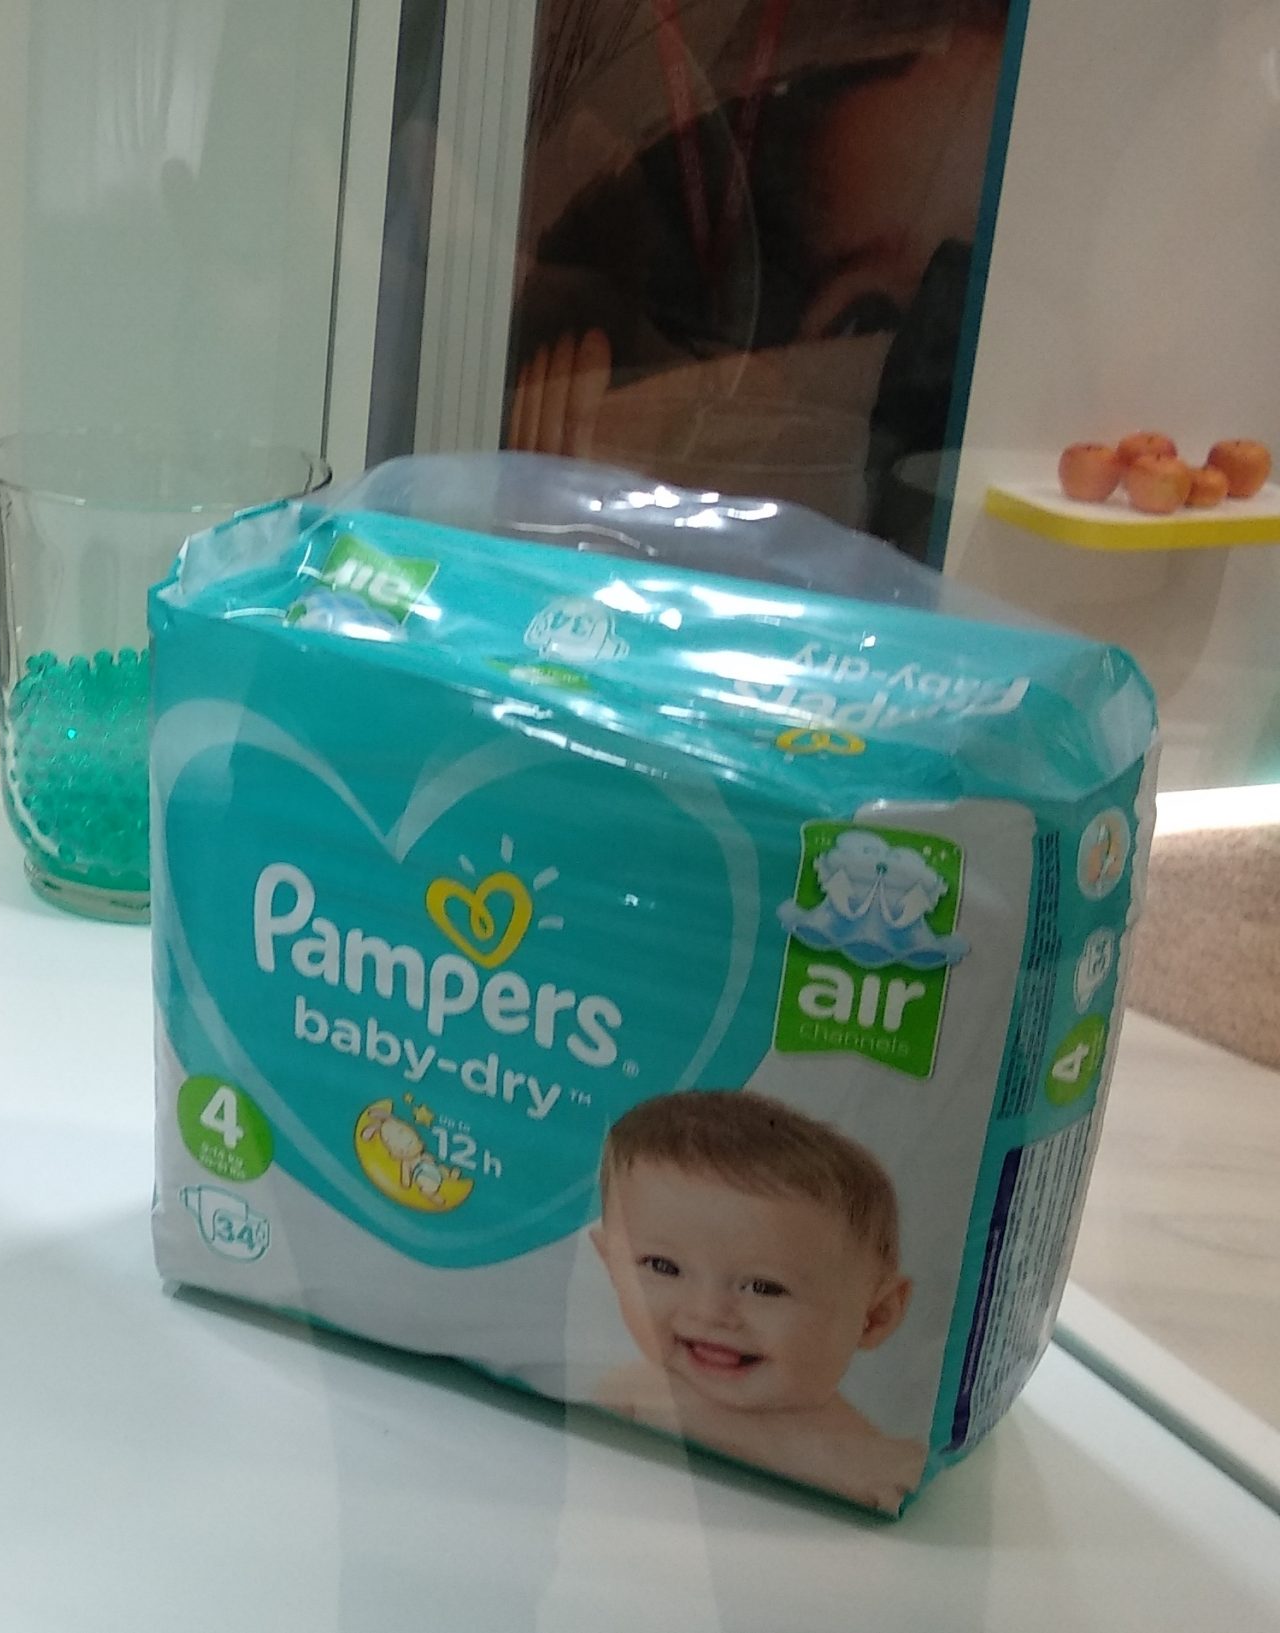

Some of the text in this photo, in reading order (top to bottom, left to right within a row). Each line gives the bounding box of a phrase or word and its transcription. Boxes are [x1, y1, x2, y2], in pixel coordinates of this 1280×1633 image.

[253, 861, 622, 1068] Pampers
[798, 963, 927, 1033] air
[293, 994, 563, 1120] baby-dry
[799, 1022, 911, 1055] channels
[1051, 1042, 1090, 1084] 4
[200, 1084, 244, 1150] 4
[215, 1214, 256, 1251] 34
